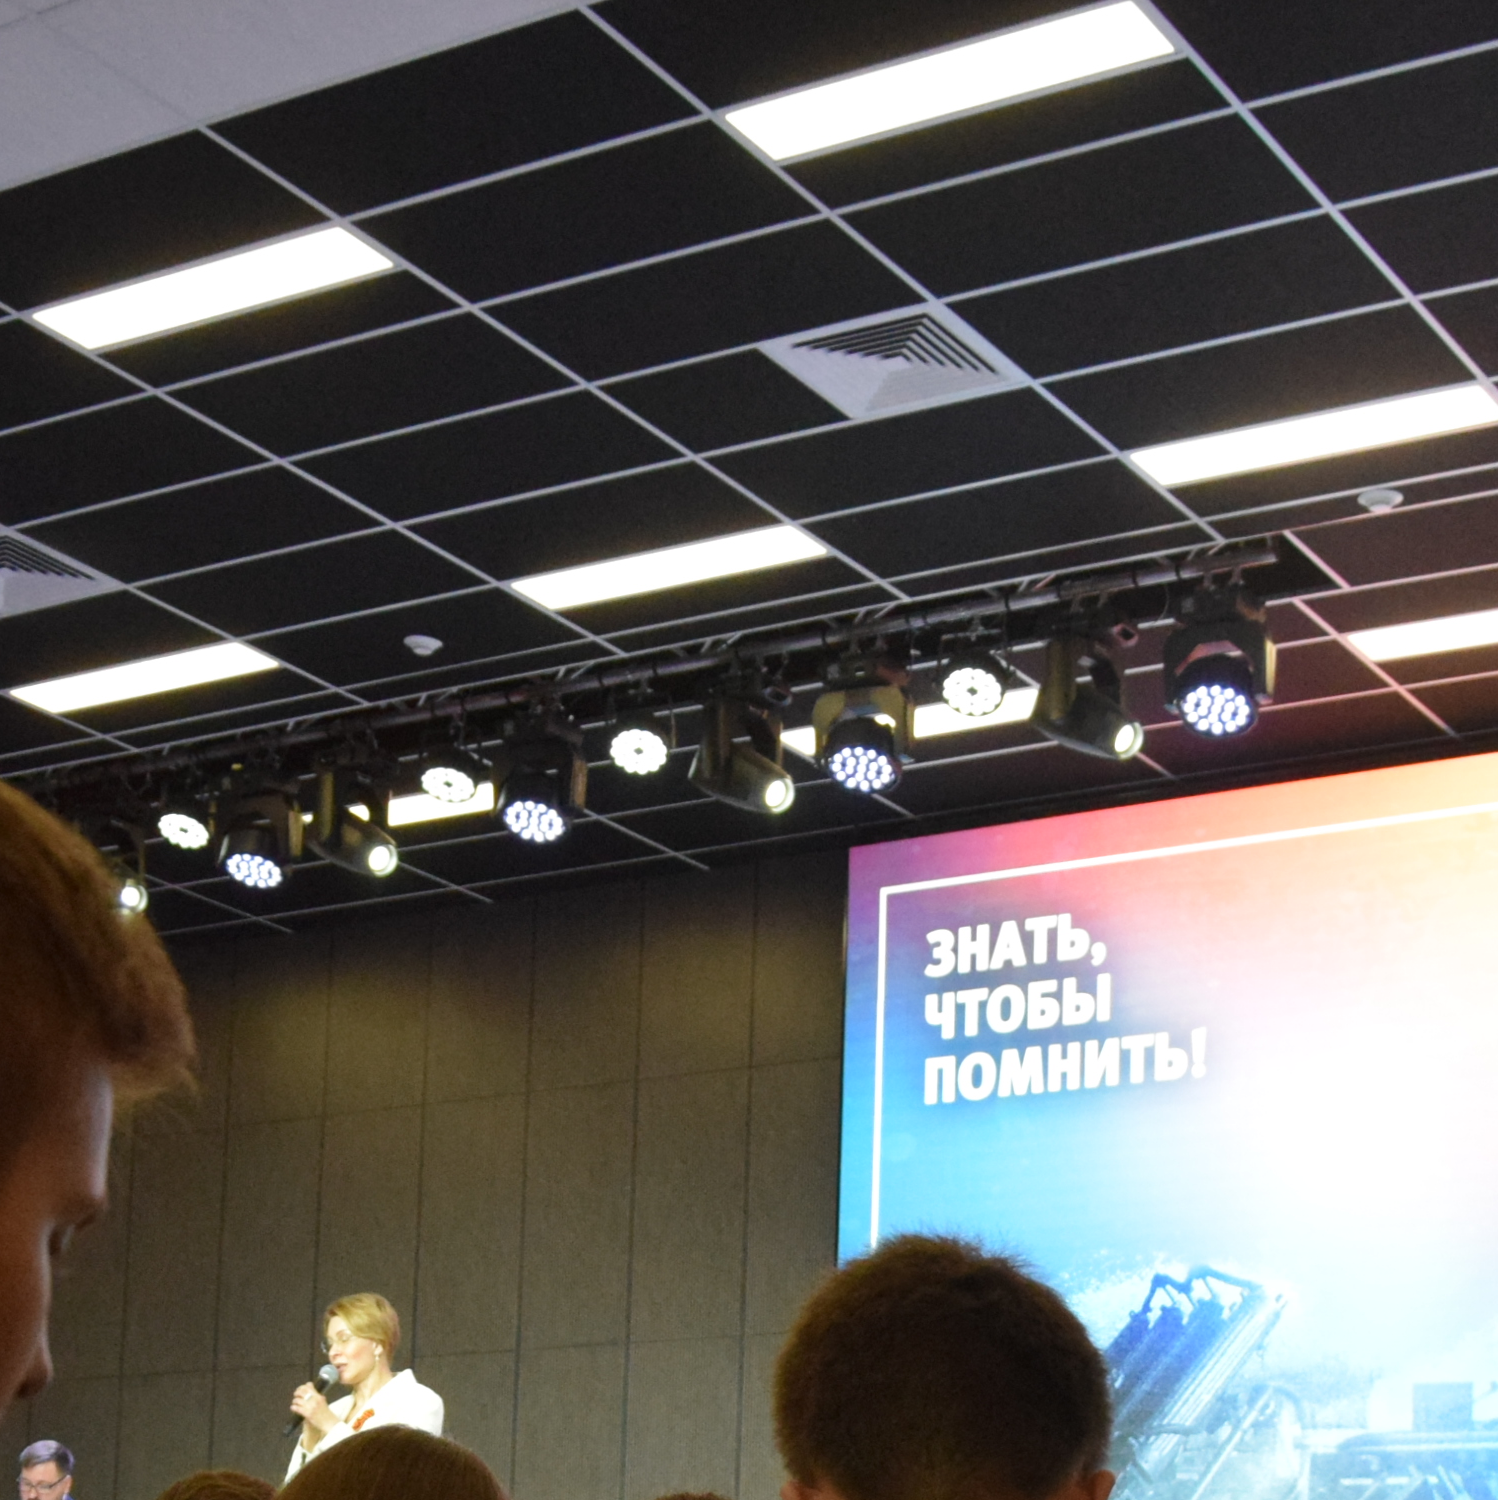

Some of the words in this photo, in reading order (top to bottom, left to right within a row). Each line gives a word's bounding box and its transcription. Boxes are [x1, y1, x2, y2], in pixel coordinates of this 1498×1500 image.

[923, 912, 1107, 978] ЗНАТЬ,
[924, 972, 1112, 1040] ЧТОБЫ
[924, 1026, 1208, 1106] ПОМНИТЬ!
